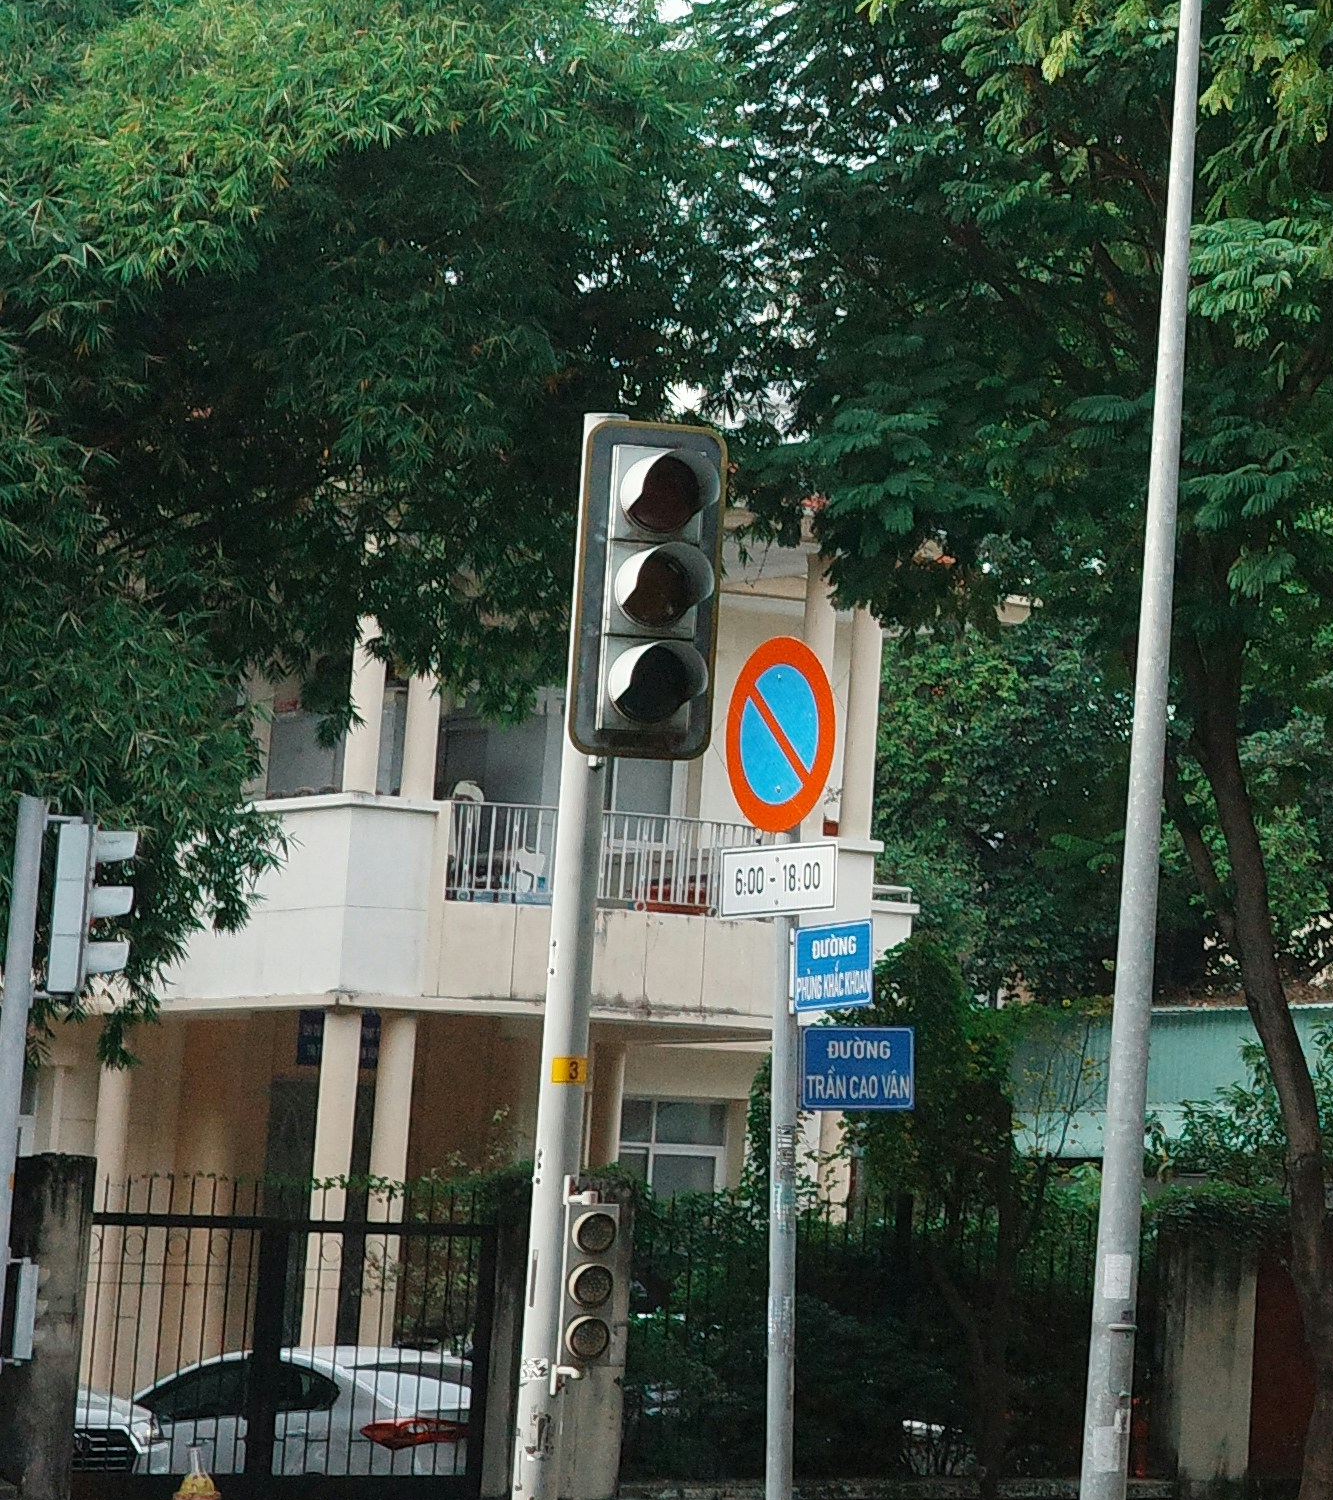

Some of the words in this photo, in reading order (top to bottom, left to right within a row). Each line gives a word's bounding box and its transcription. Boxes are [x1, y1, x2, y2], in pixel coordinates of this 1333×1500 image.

[735, 866, 765, 896] 6:00
[782, 861, 821, 893] 18:00
[812, 933, 857, 960] ĐƯỜNG
[827, 1036, 891, 1060] ĐƯỜNG
[569, 1060, 579, 1080] 3
[806, 1065, 847, 1099] TRẦN
[850, 1075, 879, 1099] CAO
[882, 1069, 911, 1099] VÂN
